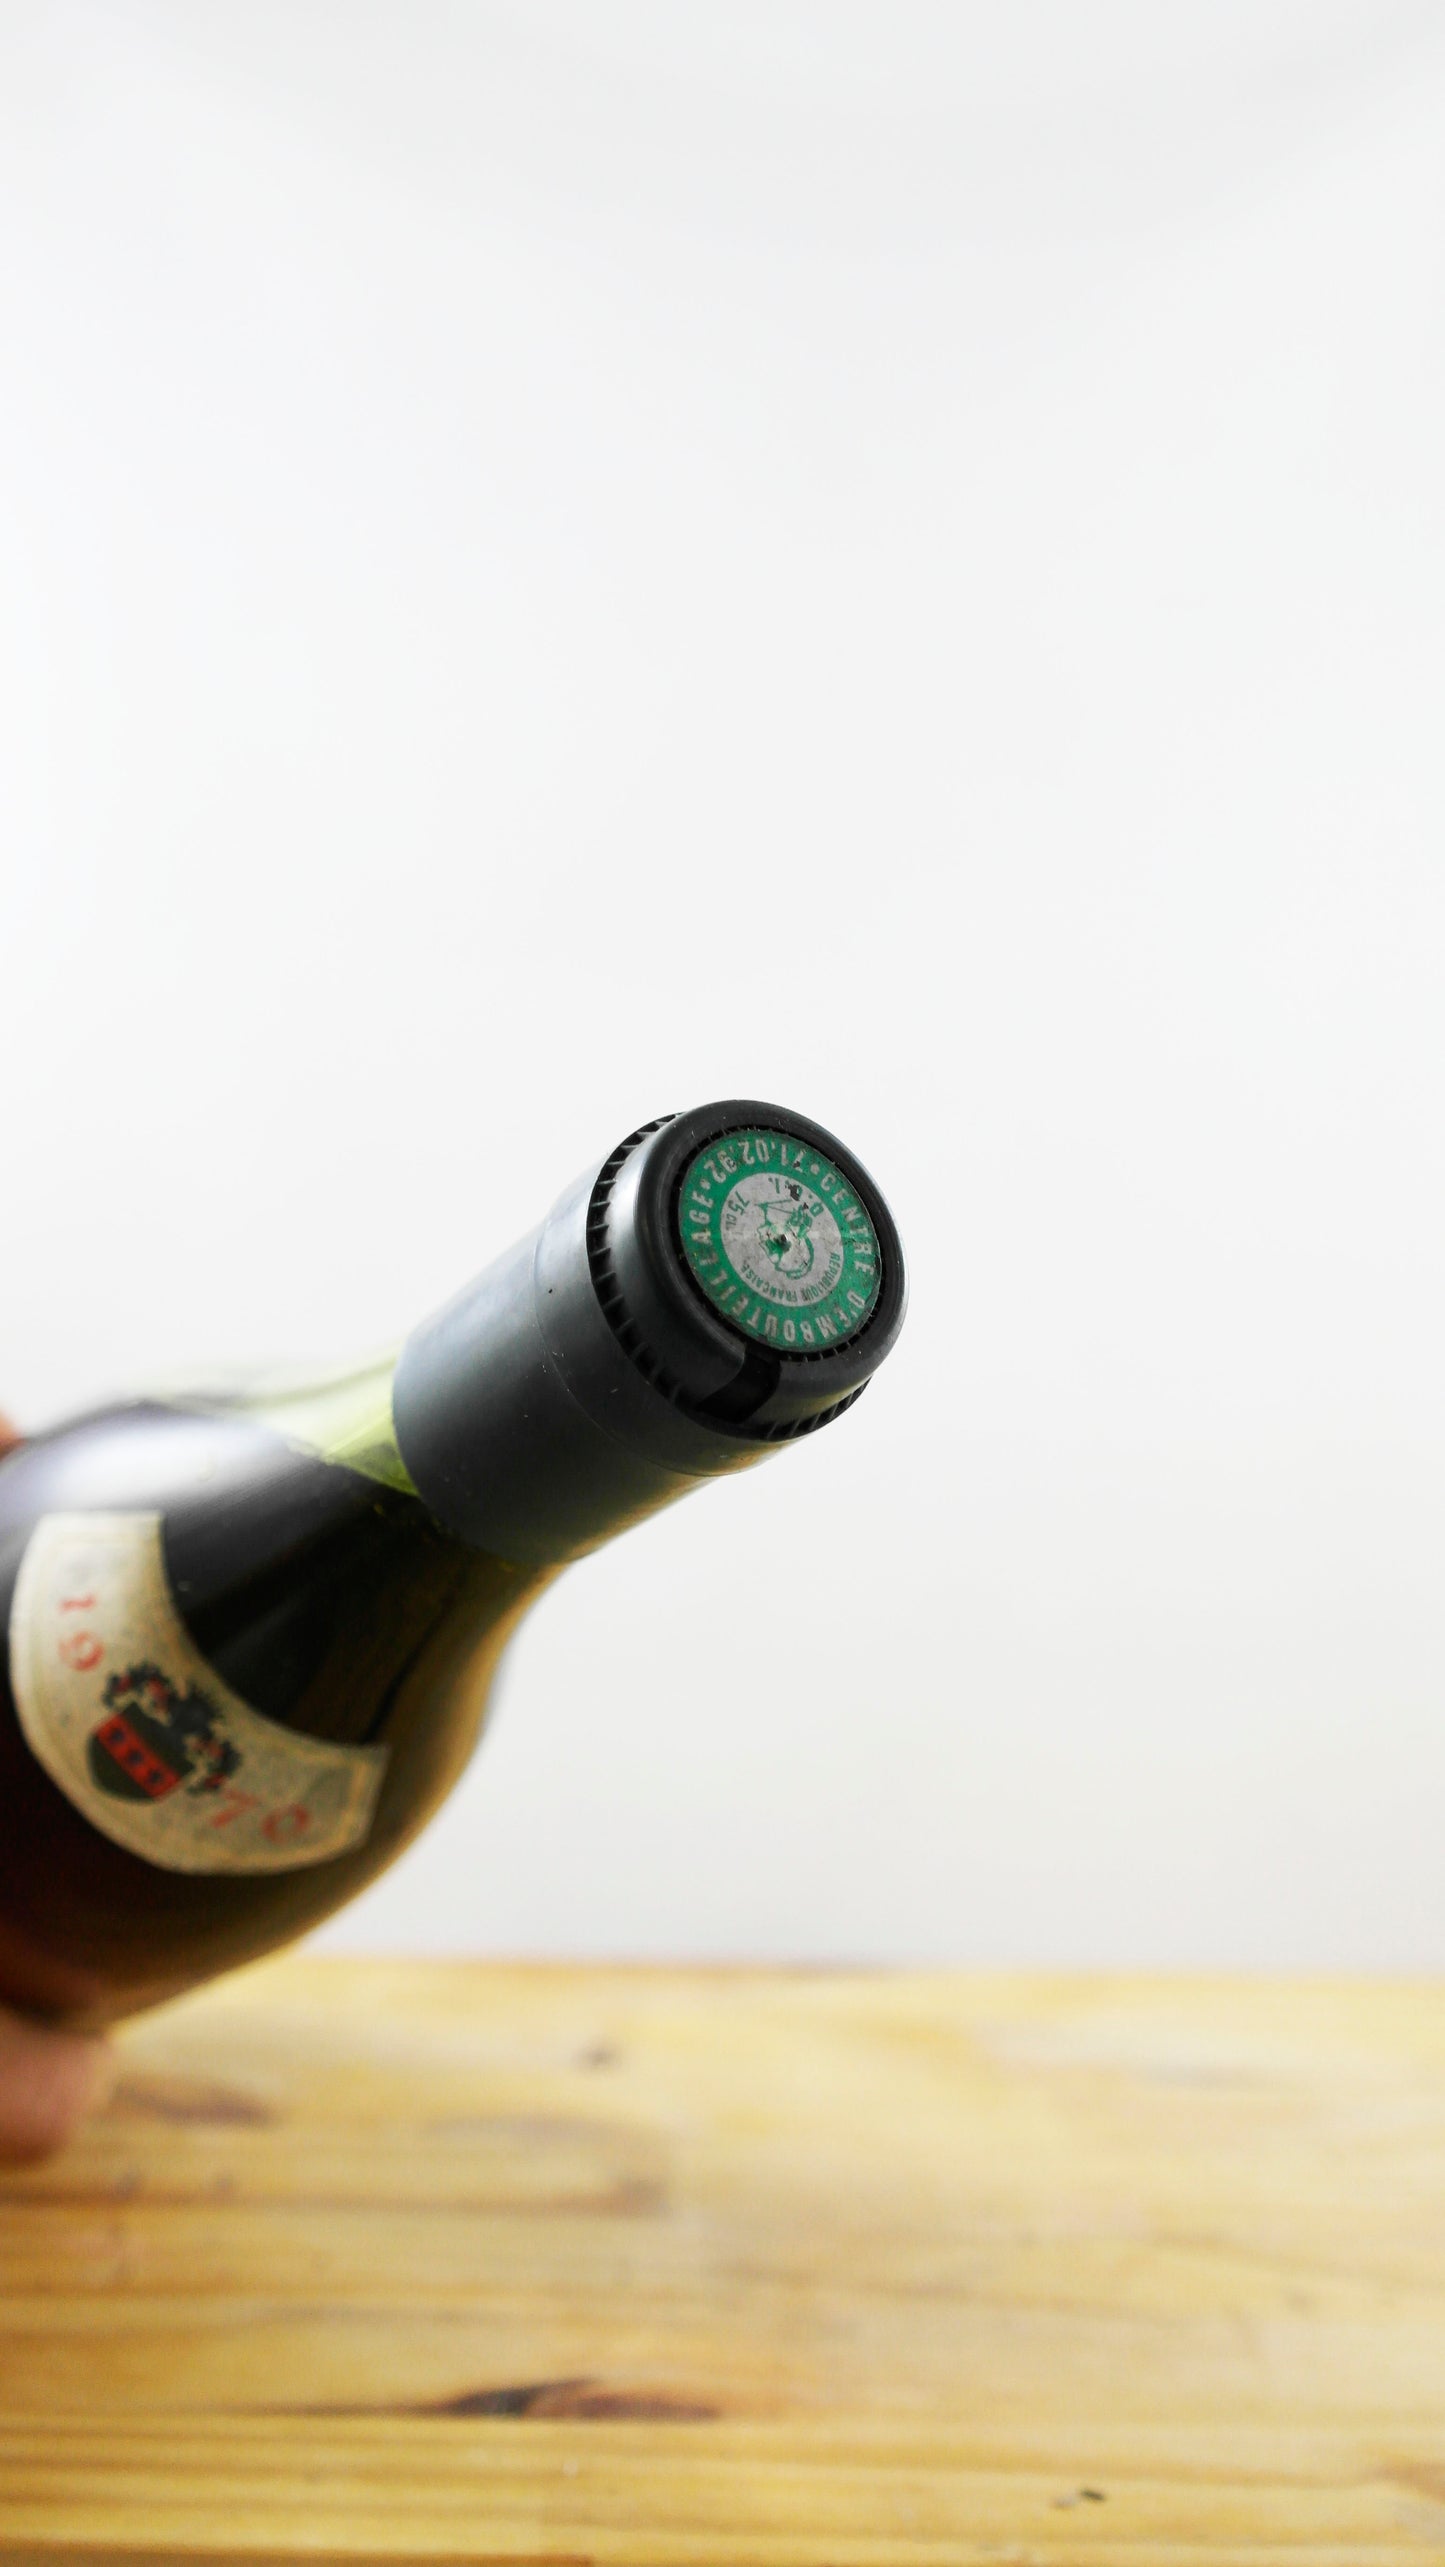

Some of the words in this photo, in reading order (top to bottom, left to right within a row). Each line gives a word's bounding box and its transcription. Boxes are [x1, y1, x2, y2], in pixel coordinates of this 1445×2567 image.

[733, 1190, 749, 1217] 75
[820, 1173, 874, 1276] CENTRE
[689, 1191, 865, 1342] D'EMBOUTEILLAGE
